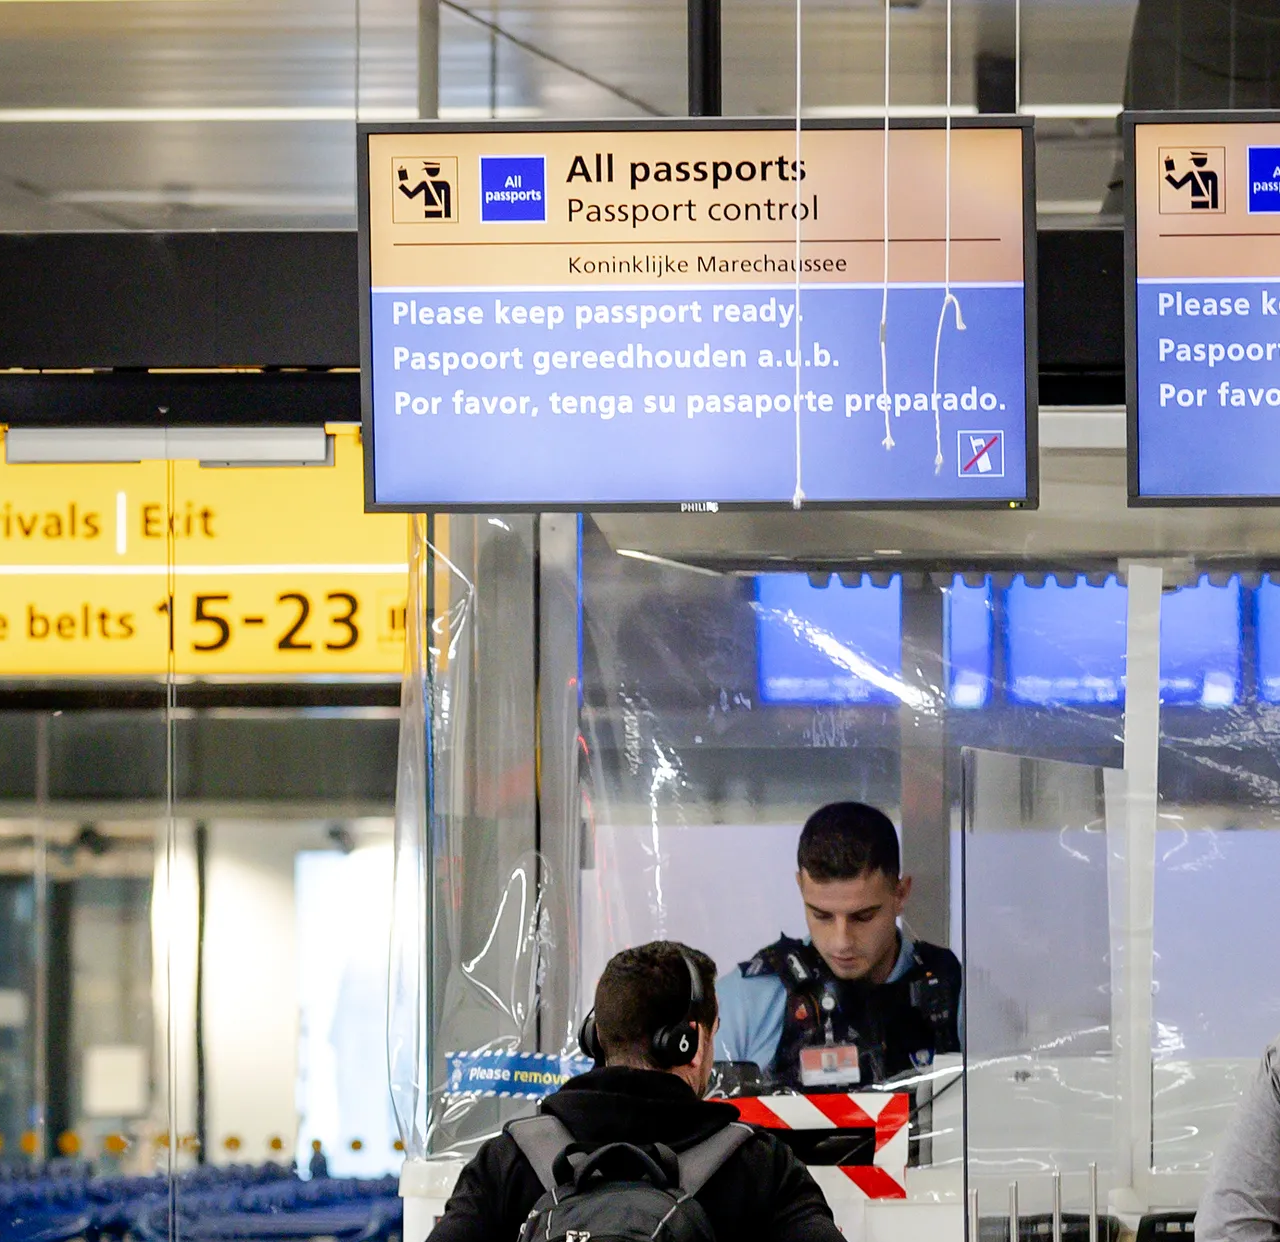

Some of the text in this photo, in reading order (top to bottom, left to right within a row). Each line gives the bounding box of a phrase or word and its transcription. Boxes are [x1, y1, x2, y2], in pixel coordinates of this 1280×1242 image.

[505, 175, 521, 188] All
[566, 154, 805, 189] All passports
[486, 189, 542, 205] passports
[569, 195, 817, 228] Passport control
[570, 255, 846, 277] Koninklijke Marechaussee
[394, 300, 802, 331] Please keep passport ready.
[1159, 292, 1250, 315] Please
[394, 343, 838, 375] Paspoort gereedhouden a.u.b.
[395, 387, 1005, 419] Por favor, tenga su pasaporte preparado.
[1160, 384, 1207, 407] Por
[27, 604, 135, 640] belts
[156, 591, 360, 653] 15-23
[469, 1066, 571, 1085] Please remove
